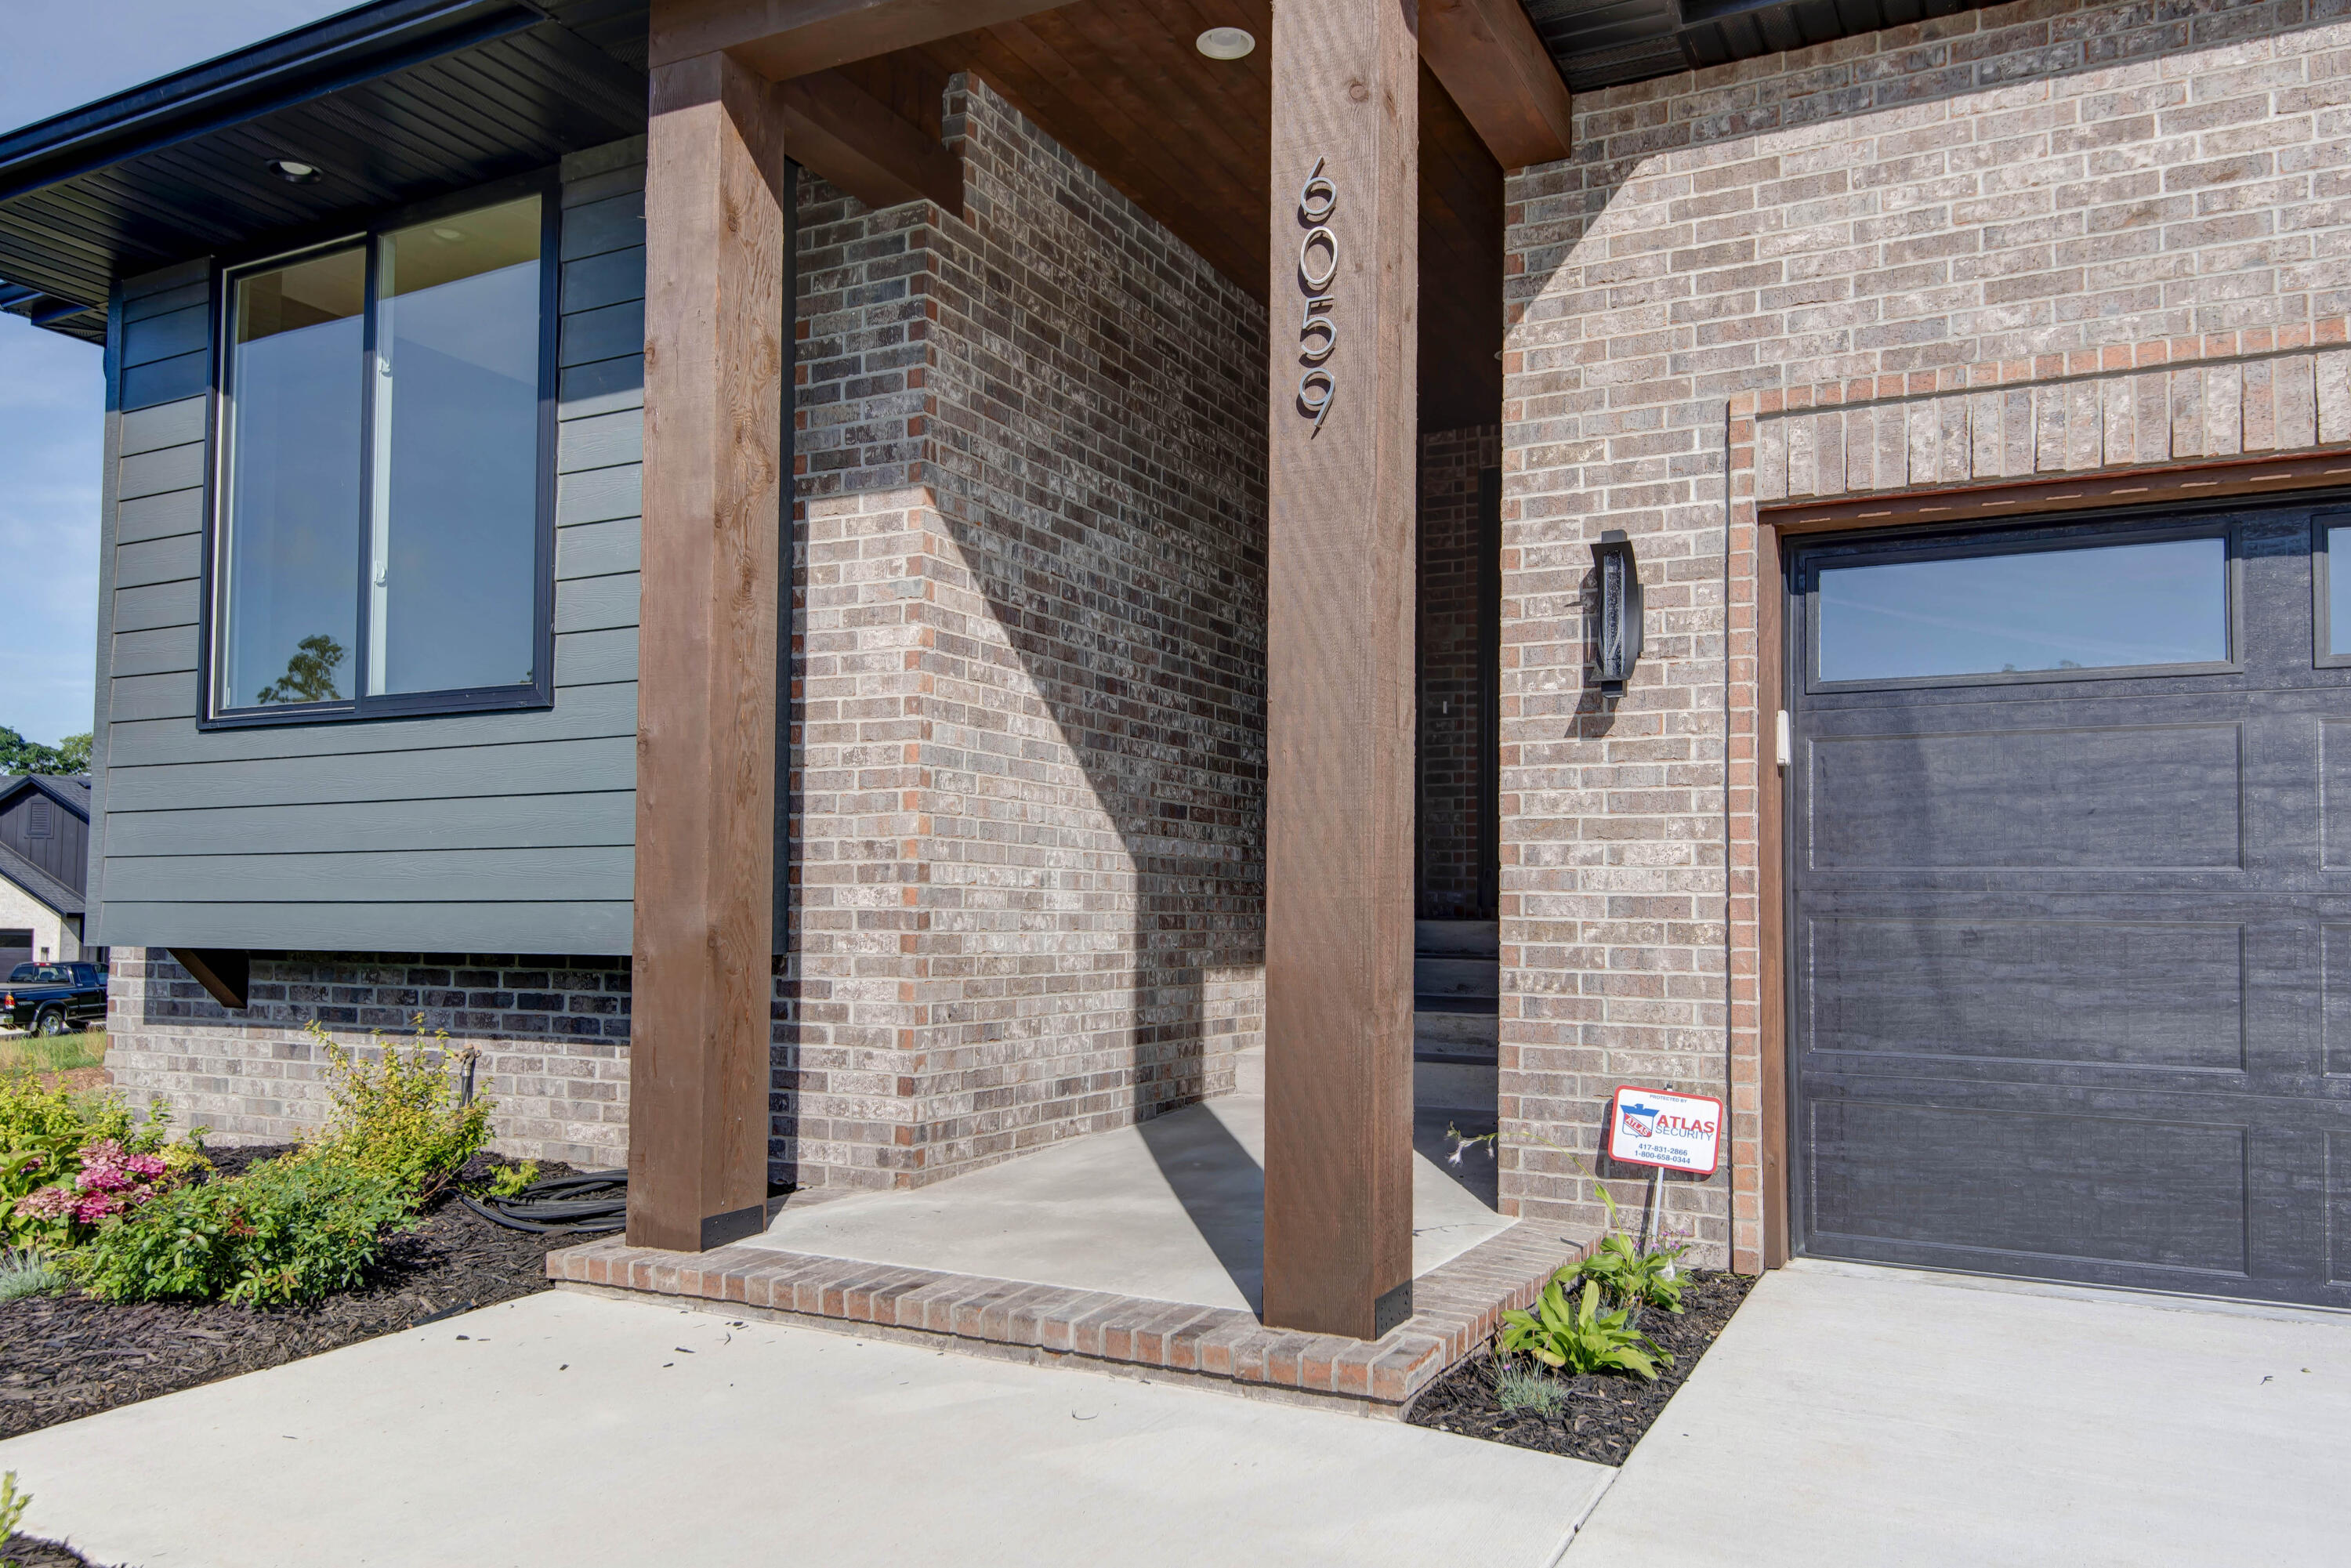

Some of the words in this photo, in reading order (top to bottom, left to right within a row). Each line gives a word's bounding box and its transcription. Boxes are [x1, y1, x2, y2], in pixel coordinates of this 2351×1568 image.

[1299, 155, 1338, 427] 6059
[1625, 1117, 1649, 1137] ATLAS
[1657, 1114, 1715, 1133] ATLAS
[1655, 1125, 1714, 1141] SECURITY
[1635, 1150, 1690, 1164] 1-800-658-0344
[1639, 1143, 1688, 1157] 417-831-2866
